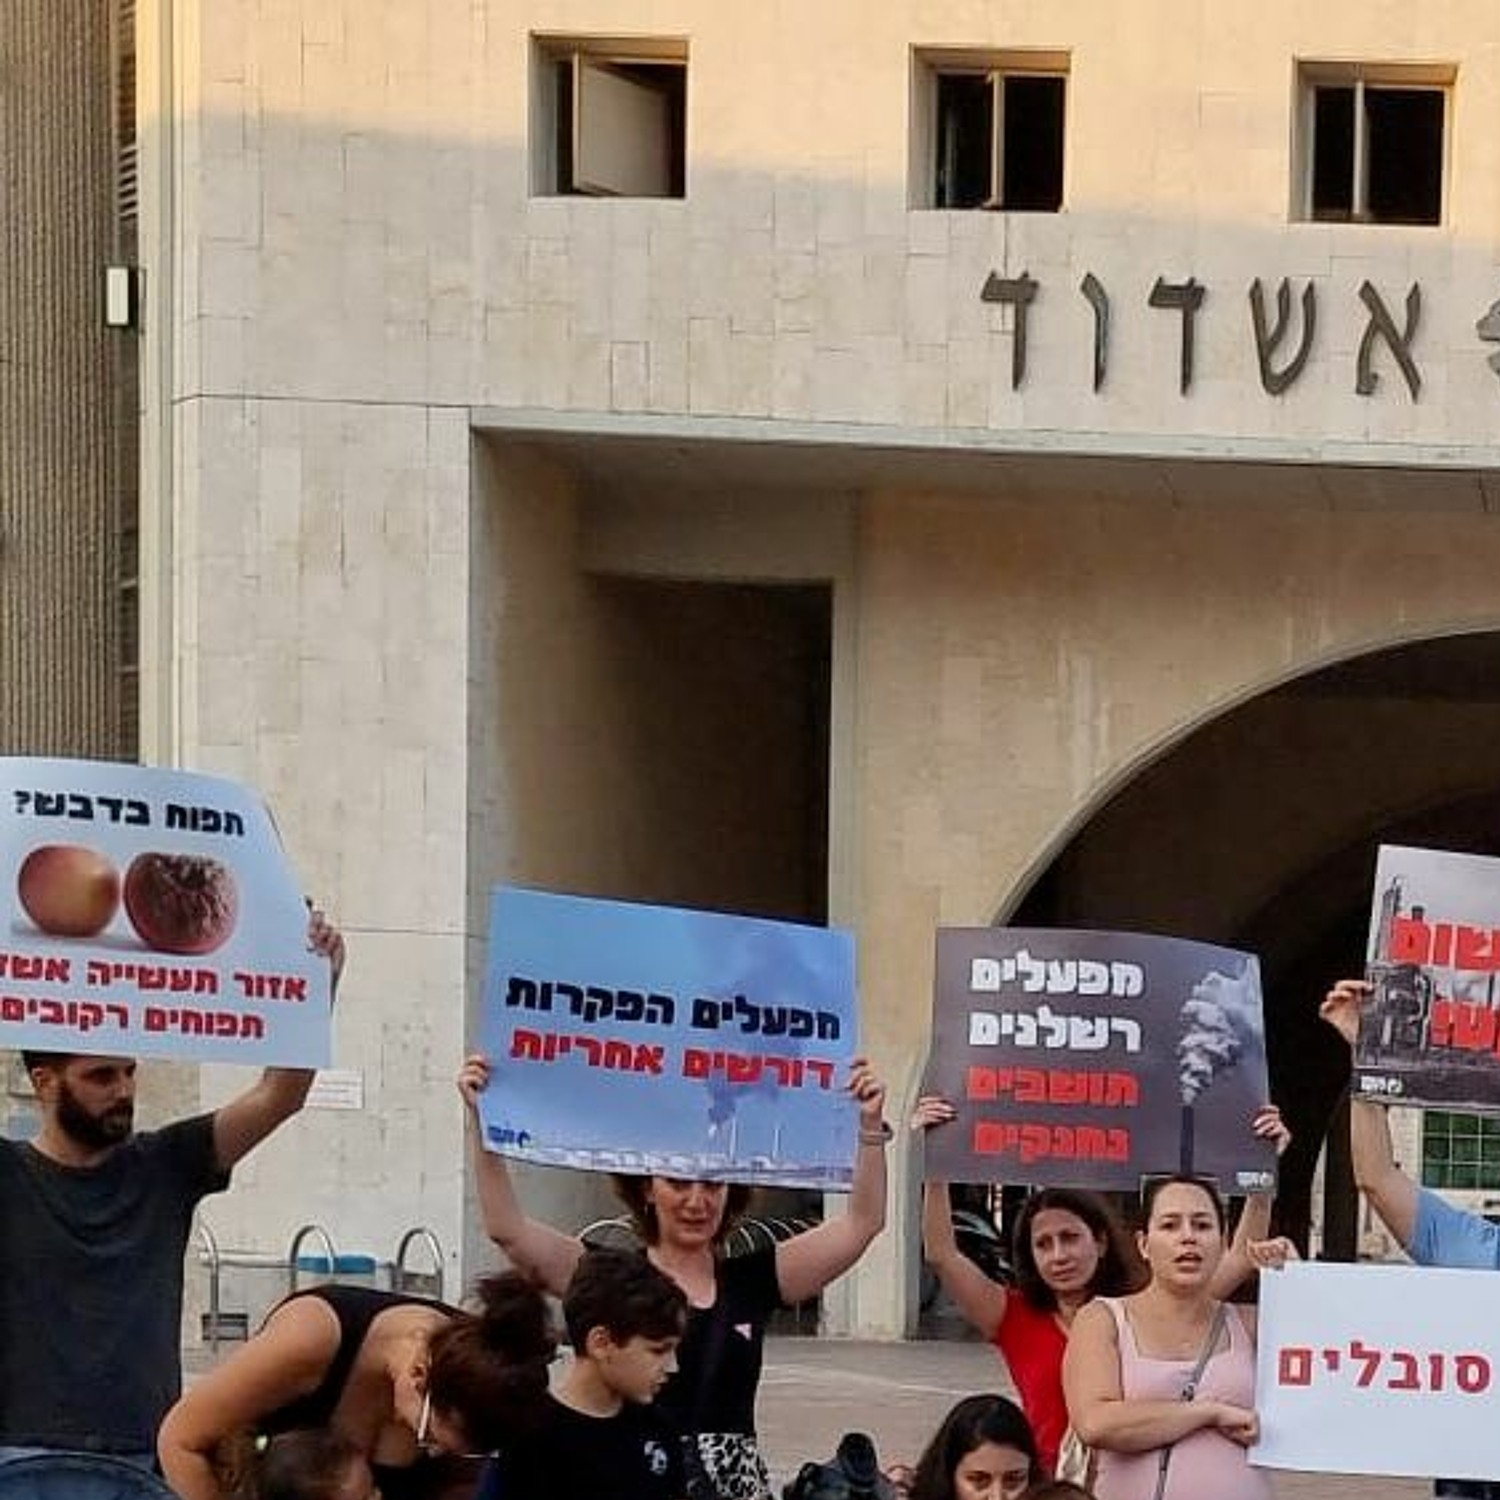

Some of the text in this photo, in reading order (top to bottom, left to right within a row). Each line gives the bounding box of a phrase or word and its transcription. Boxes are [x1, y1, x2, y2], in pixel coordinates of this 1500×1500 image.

[980, 270, 1423, 404] אשדוד
[13, 789, 245, 836] תפוח בדבש?
[87, 961, 219, 994] תעשייה
[233, 971, 307, 1002] אזור
[970, 948, 1145, 998] מפעלים
[1, 996, 265, 1040] תפוחים רקובים
[506, 976, 675, 1025] הפקרות
[968, 1003, 1143, 1053] רשלנים
[510, 1029, 836, 1090] דורשים אחריות
[966, 1065, 1139, 1107] תושבים
[974, 1120, 1130, 1165] נחנקים
[1277, 1341, 1493, 1394] סובלים
